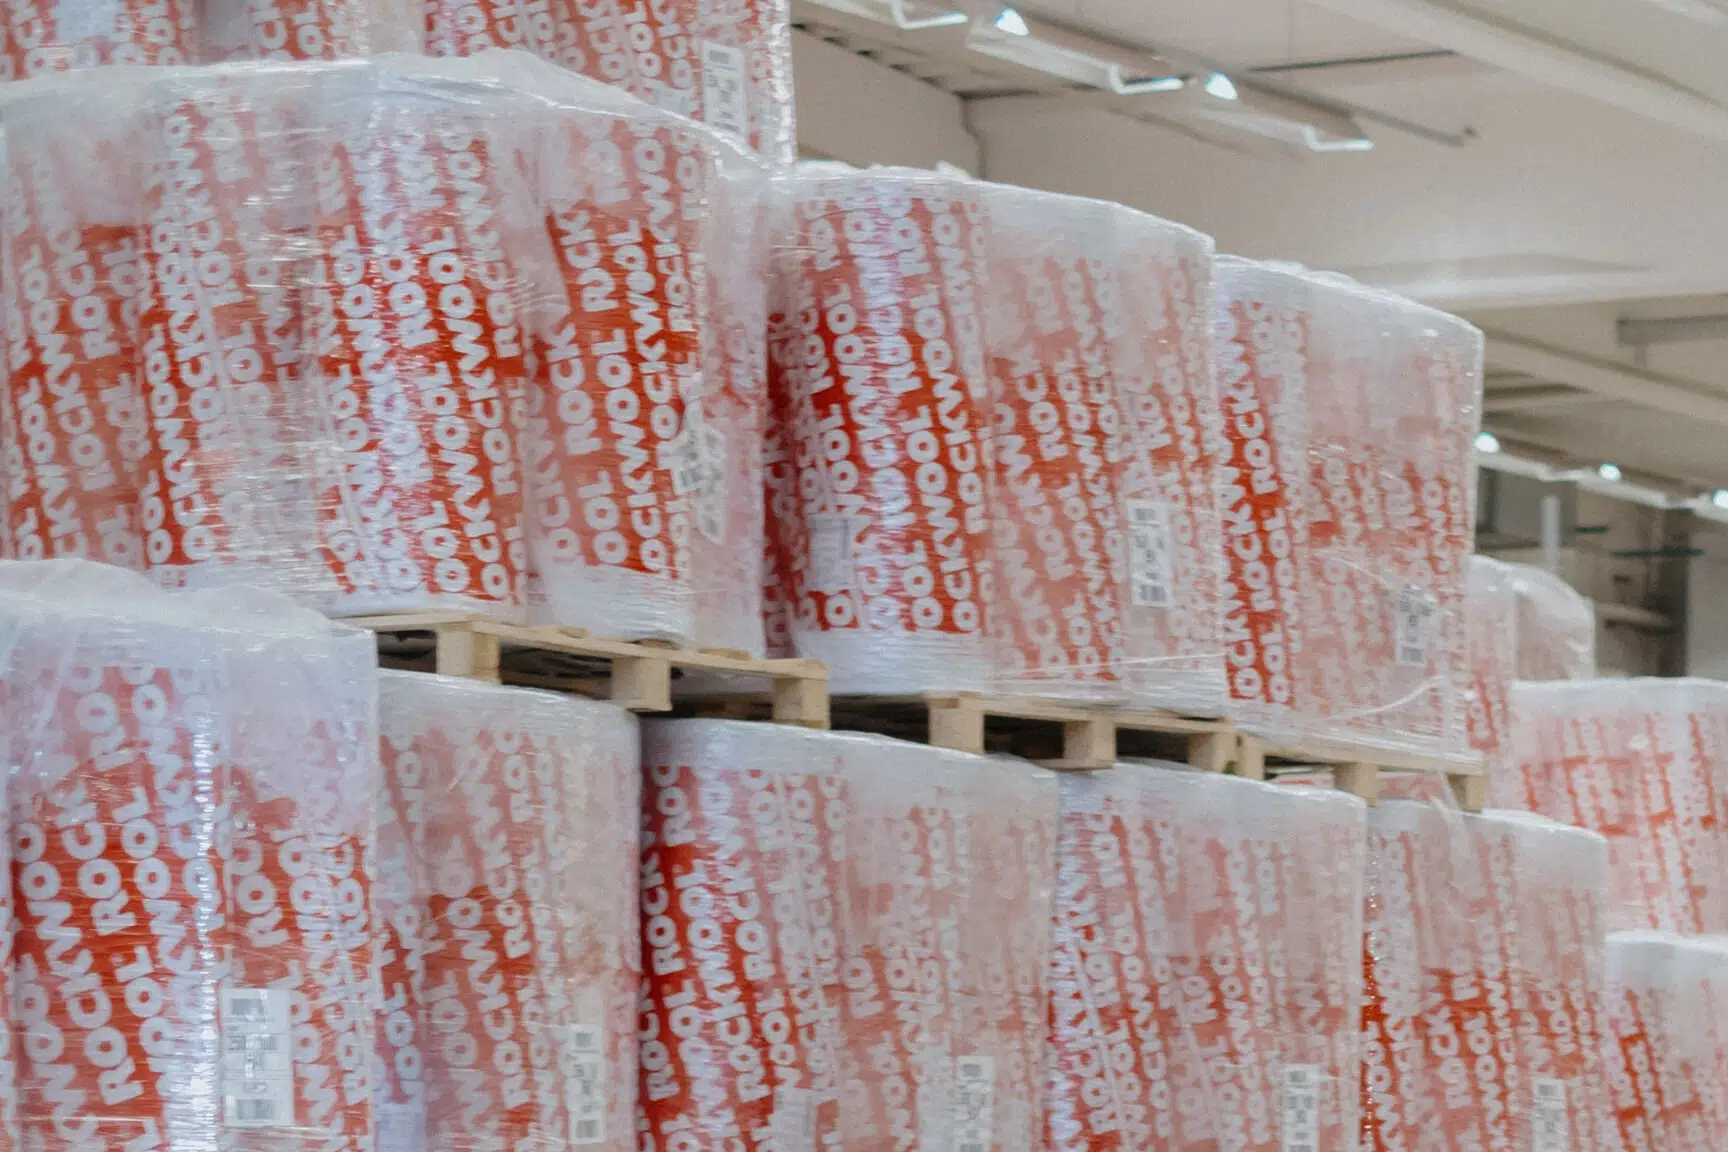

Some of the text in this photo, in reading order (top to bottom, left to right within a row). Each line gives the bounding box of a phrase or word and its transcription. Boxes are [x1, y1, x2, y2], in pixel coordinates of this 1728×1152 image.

[143, 324, 214, 561] OCKWOOL
[411, 362, 508, 597] OCKWOOL
[590, 329, 668, 572] OCKWOOL
[820, 404, 903, 628] OCKWOOL
[900, 406, 977, 632] OCKWOOL
[909, 284, 988, 534] ROCKWOOL
